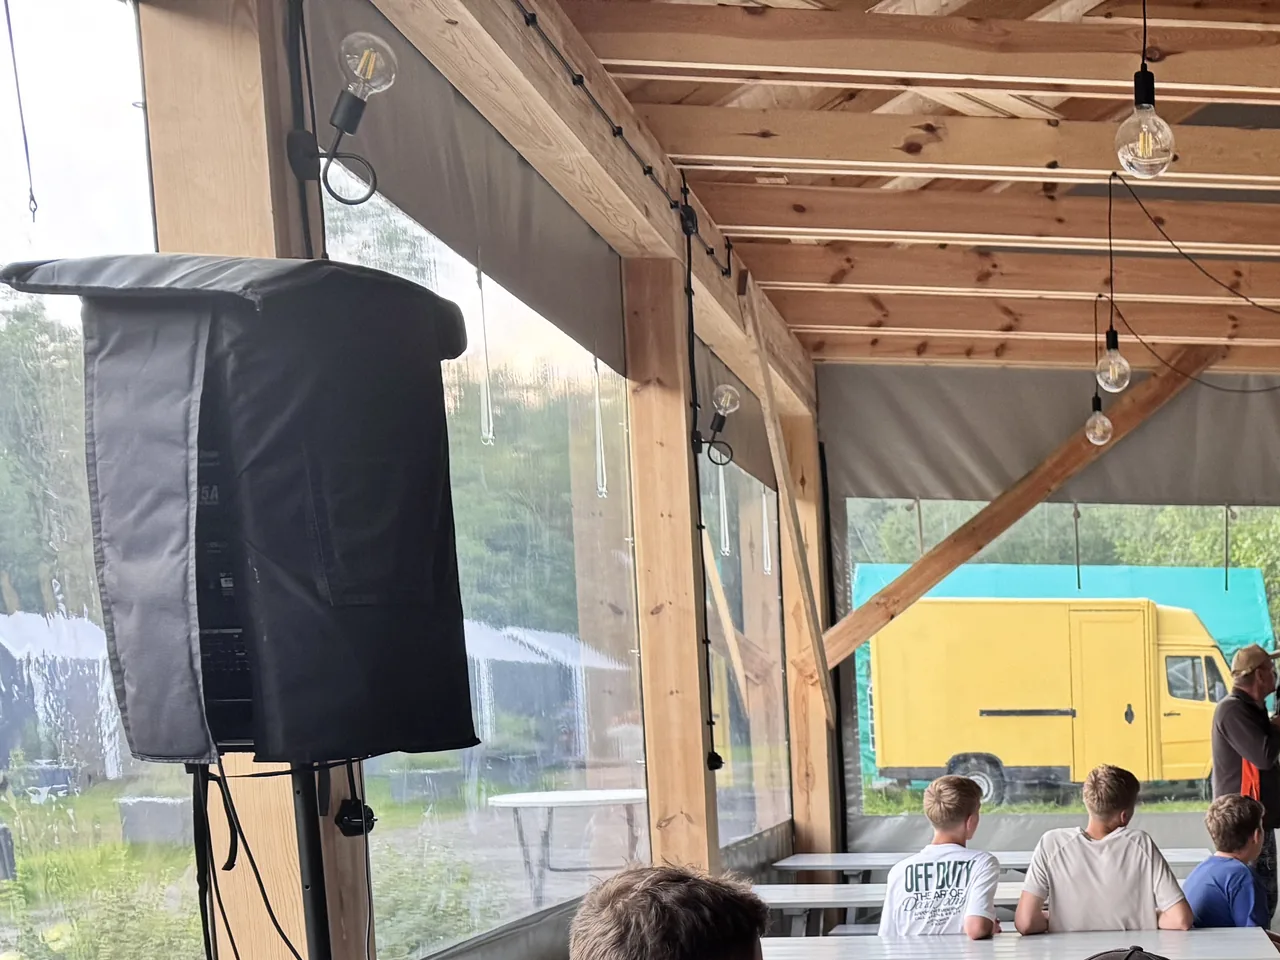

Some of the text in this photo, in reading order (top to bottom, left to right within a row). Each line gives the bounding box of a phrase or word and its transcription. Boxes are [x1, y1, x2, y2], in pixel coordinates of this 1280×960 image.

[905, 860, 977, 892] OFF DUTY
[914, 888, 964, 901] THE AR OF
